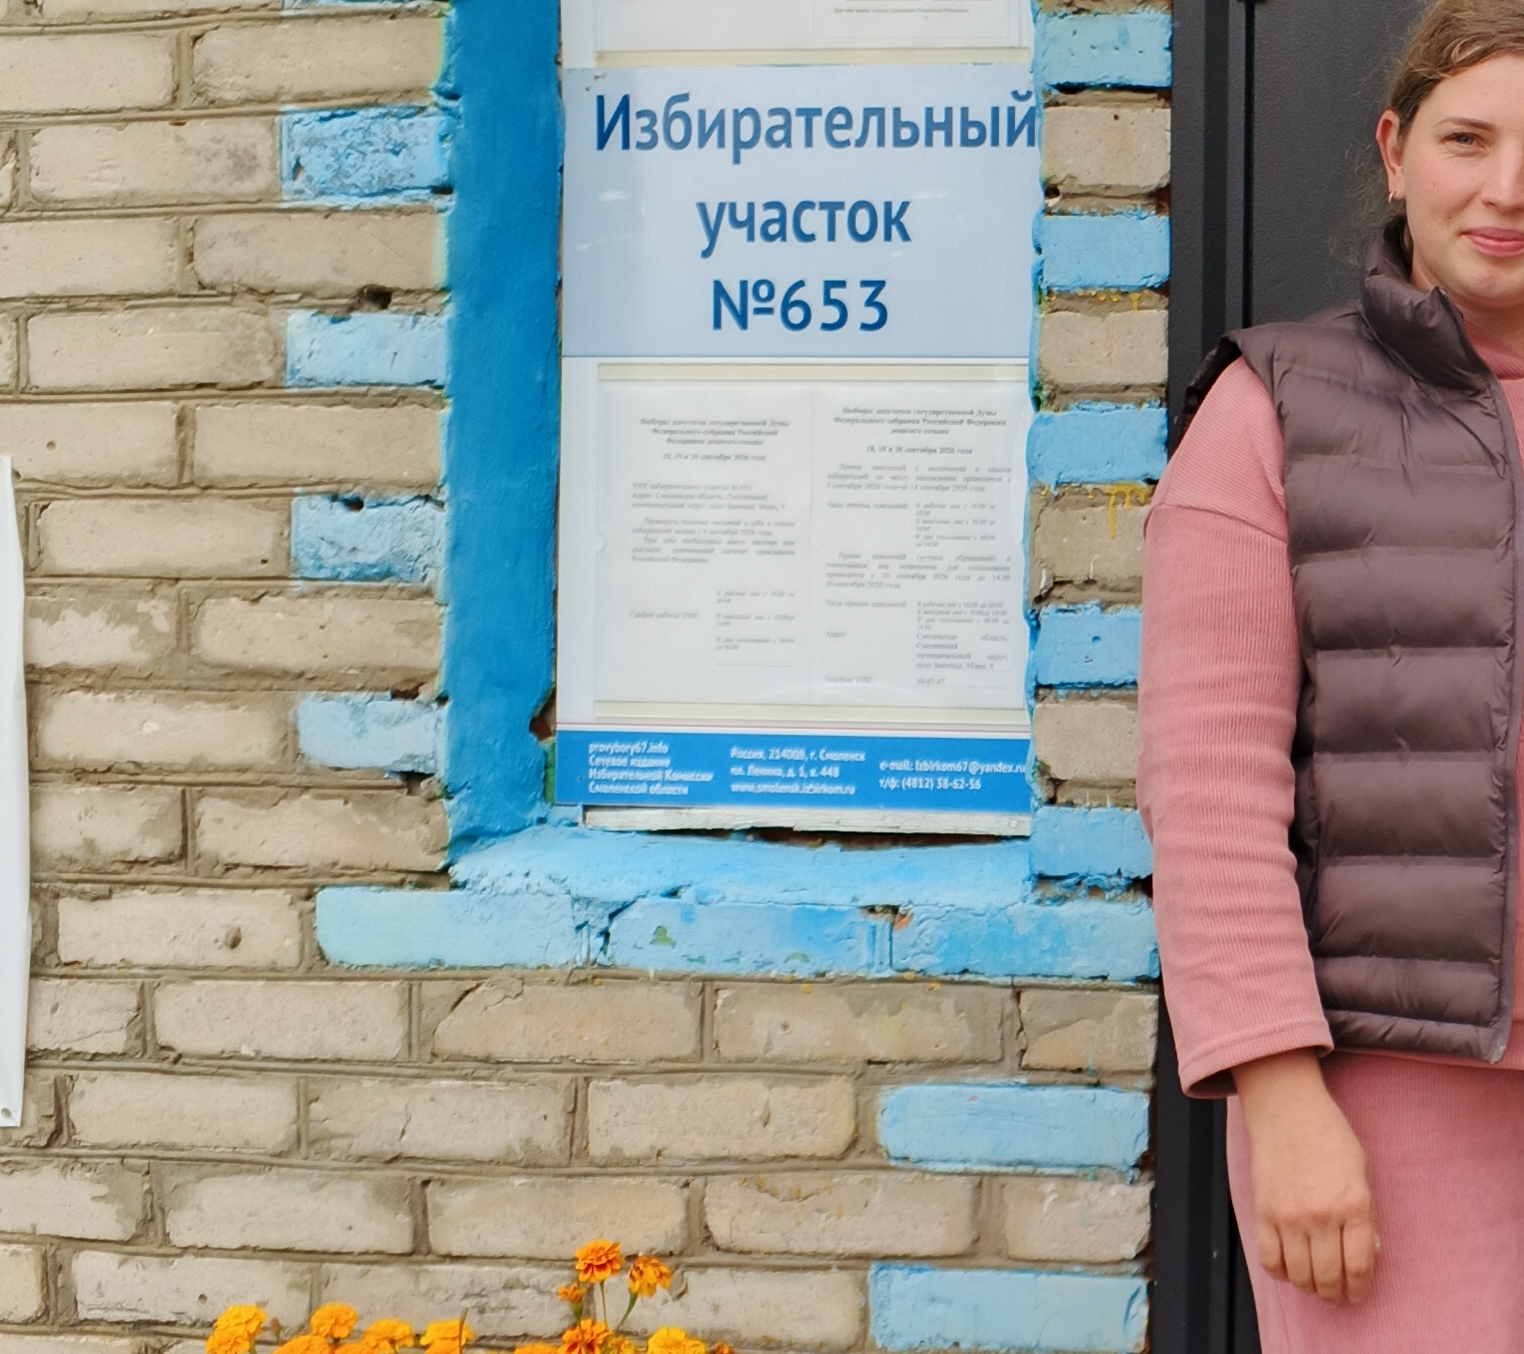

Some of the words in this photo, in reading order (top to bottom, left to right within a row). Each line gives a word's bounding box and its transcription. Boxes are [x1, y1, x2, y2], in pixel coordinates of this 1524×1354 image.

[595, 89, 1036, 165] Избирательный
[697, 199, 912, 259] участок
[712, 278, 889, 331] №653
